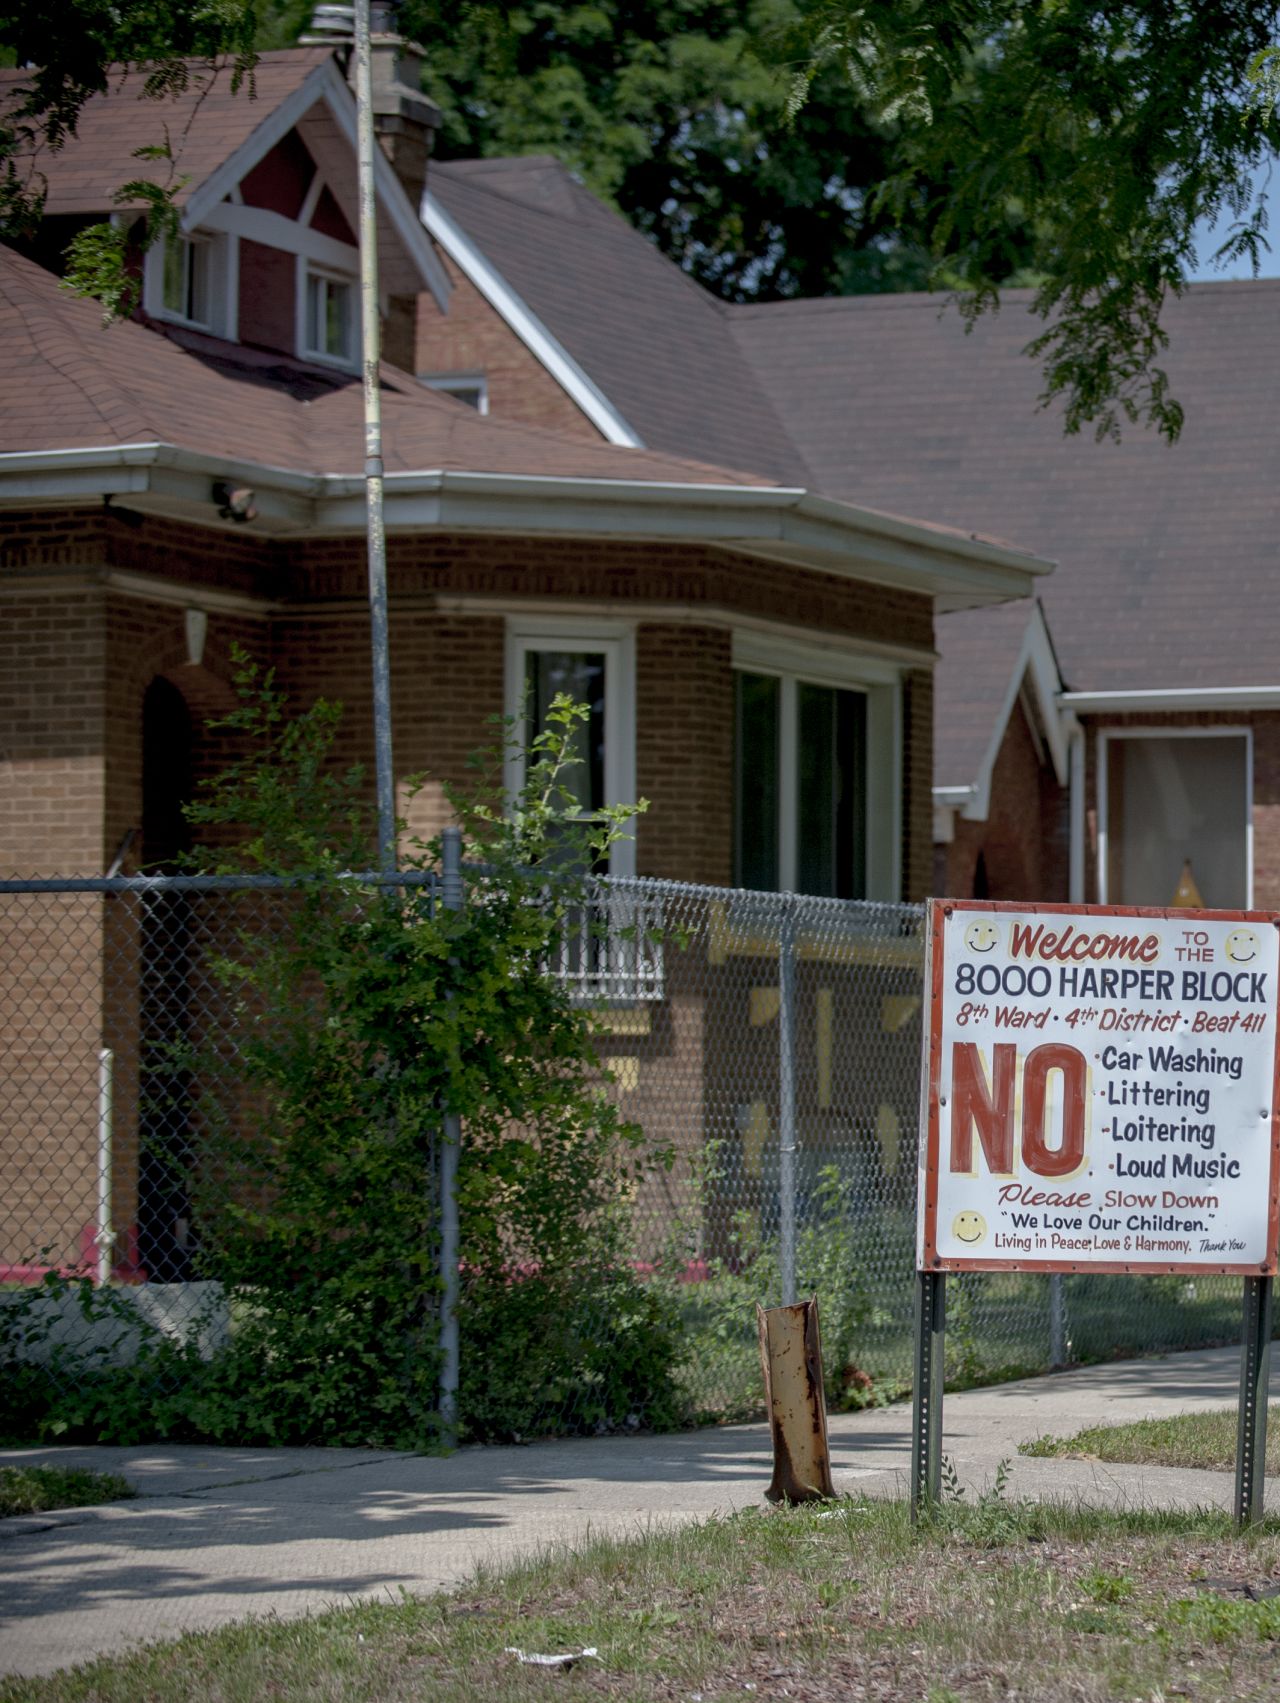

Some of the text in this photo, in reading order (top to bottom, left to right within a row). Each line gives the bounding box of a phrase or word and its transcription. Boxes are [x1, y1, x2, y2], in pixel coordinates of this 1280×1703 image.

[1011, 922, 1160, 963] Welcome
[1182, 931, 1209, 946] TO
[1174, 947, 1215, 963] THE
[955, 962, 1268, 1003] 8000 HARPER BLOCK
[956, 1002, 1267, 1034] 8th Ward 4th District Beat 411
[1101, 1045, 1243, 1079] Car Washing
[950, 1041, 1088, 1177] NO
[1108, 1080, 1210, 1114] Littering
[1112, 1115, 1216, 1149] Loitering
[1116, 1152, 1241, 1179] Loud Music
[998, 1183, 1219, 1209] Please Slow Down
[1043, 1213, 1083, 1230] Love
[1088, 1213, 1121, 1231] Our
[995, 1233, 1032, 1252] Living
[1035, 1233, 1047, 1248] in
[1093, 1235, 1121, 1250] Love
[1123, 1235, 1132, 1251] &
[1135, 1235, 1192, 1255] Harmony.
[1199, 1238, 1227, 1253] Thank
[1227, 1238, 1247, 1252] You
